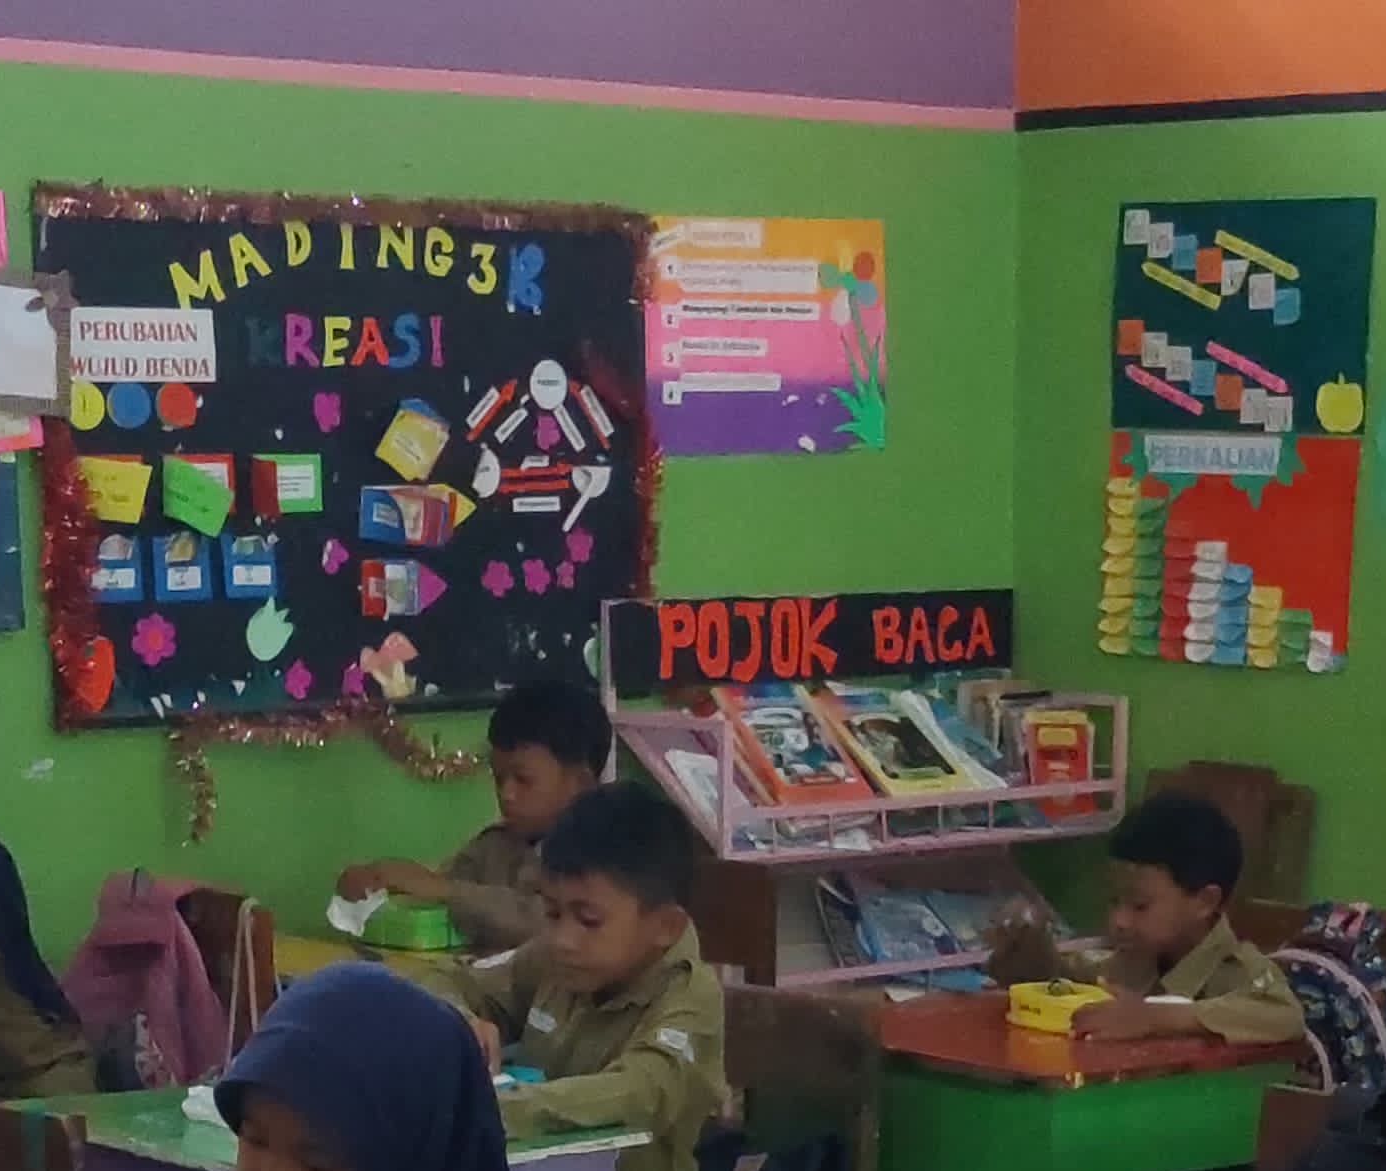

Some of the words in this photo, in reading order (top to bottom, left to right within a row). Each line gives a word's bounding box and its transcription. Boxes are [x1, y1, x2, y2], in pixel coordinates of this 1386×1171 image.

[169, 221, 455, 310] MADING
[79, 321, 198, 344] PERUBAHAN
[247, 312, 445, 369] KREASI
[71, 356, 139, 378] WUJUD
[145, 356, 211, 378] BENDA
[1149, 440, 1276, 470] PERKALIAN
[658, 598, 838, 683] POJOK
[872, 605, 995, 665] BACA
